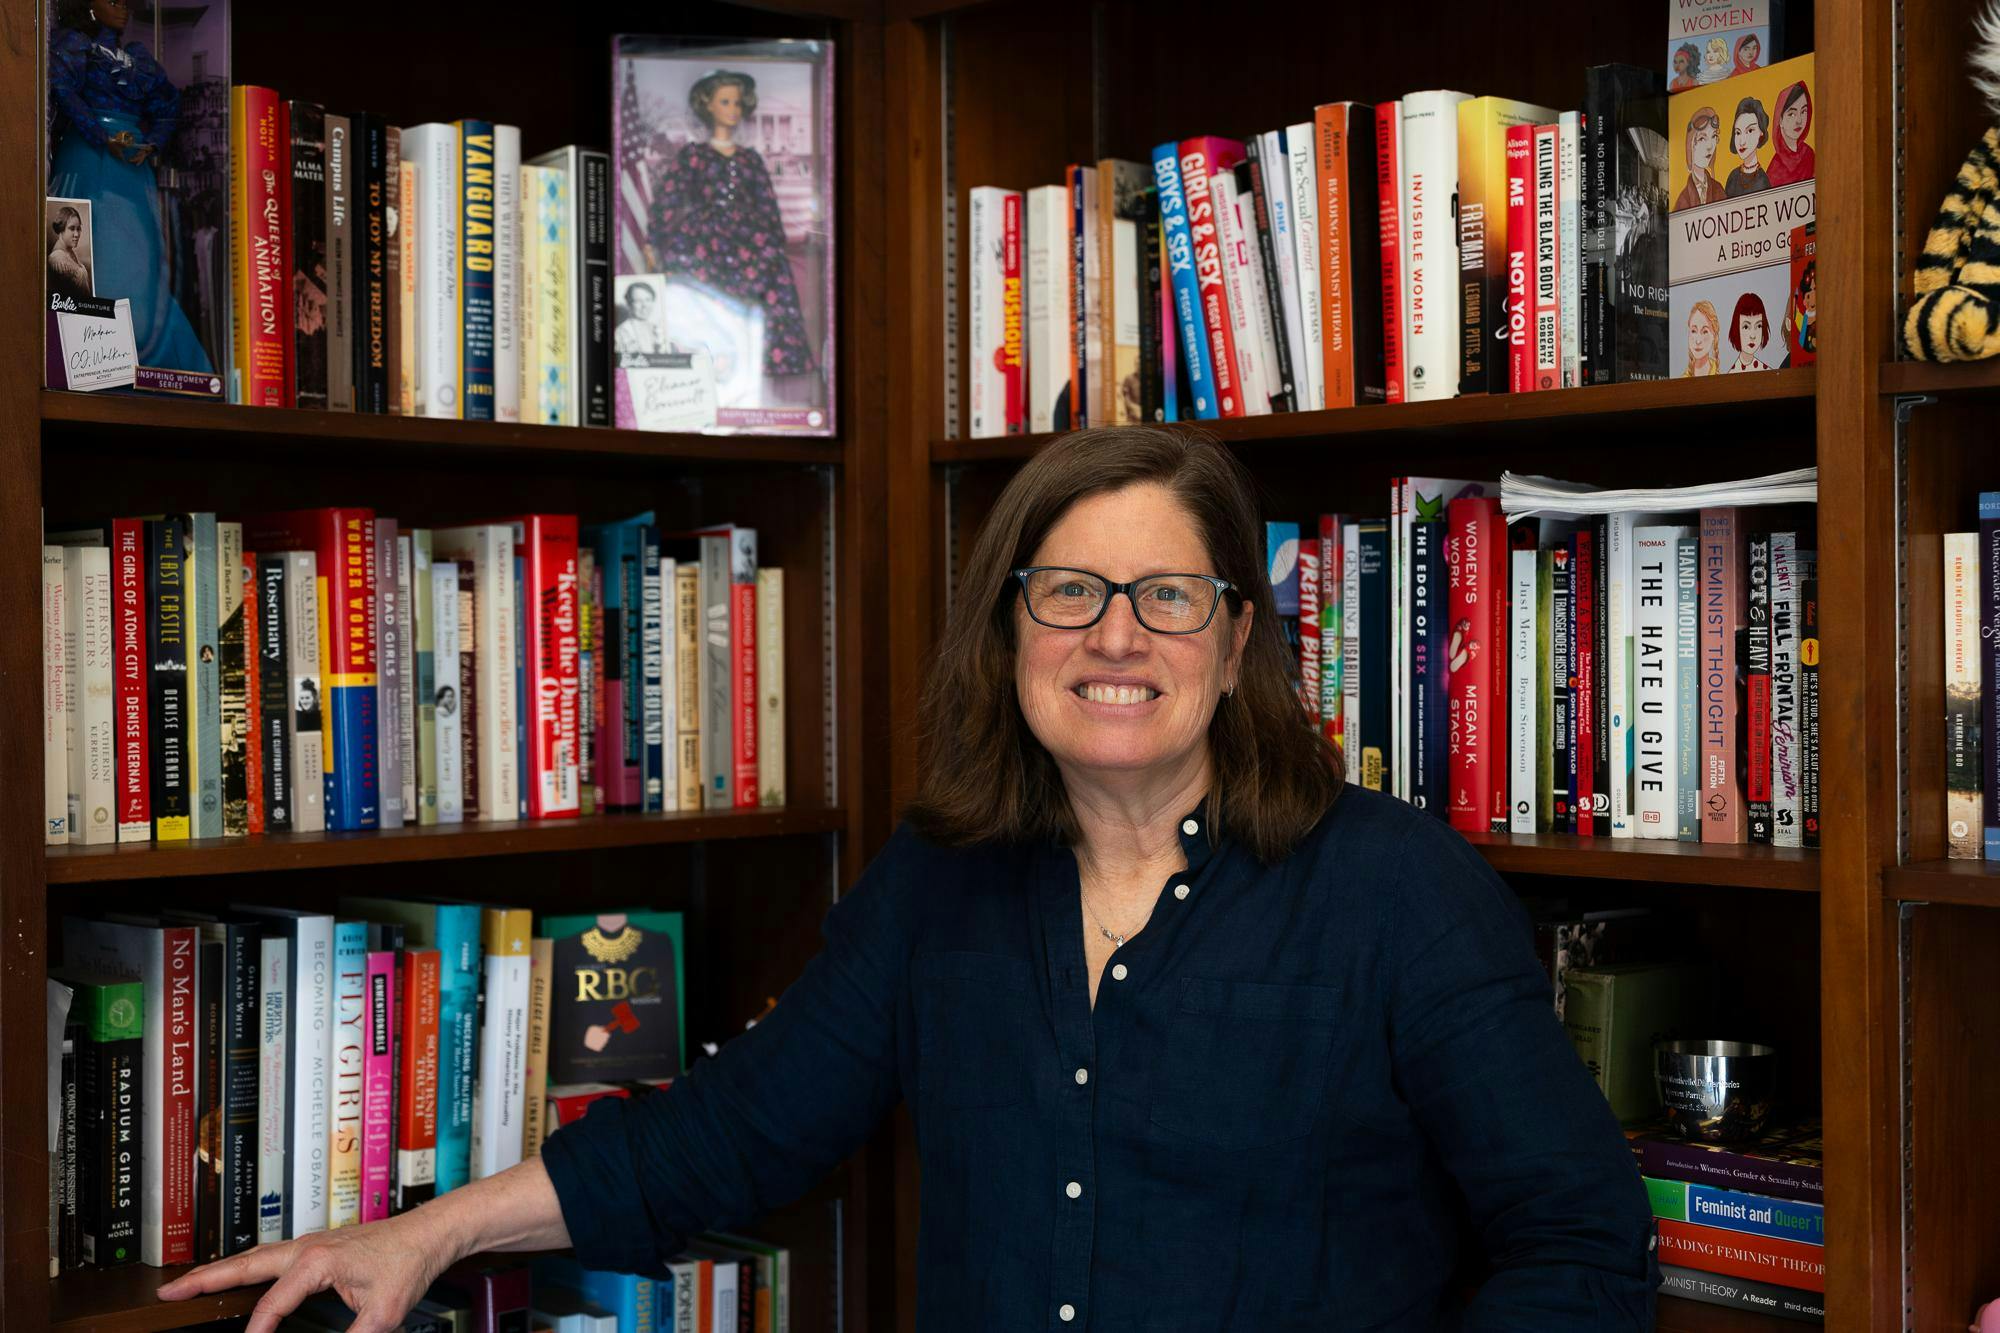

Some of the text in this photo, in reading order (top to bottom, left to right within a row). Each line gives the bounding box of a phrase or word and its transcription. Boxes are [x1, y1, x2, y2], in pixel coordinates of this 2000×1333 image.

[1682, 7, 1754, 33] WOMEN
[259, 118, 269, 148] HOLT
[266, 105, 276, 162] NATHALIA
[293, 170, 324, 182] MATER
[295, 160, 323, 172] ALMA
[331, 126, 345, 226] Campus Life
[369, 181, 381, 206] TO
[262, 169, 282, 281] The QUEENS of
[368, 212, 381, 245] JOY
[466, 134, 493, 273] VANGUARD
[1539, 137, 1554, 300] KILLING THE BLACK BODY
[1685, 203, 1769, 243] WONDER
[369, 250, 382, 277] MY
[1412, 173, 1424, 336] INVISIBLE WOMEN
[1461, 203, 1484, 271] FREEMAN
[1717, 244, 1726, 262] A
[1731, 238, 1772, 259] Bingo
[254, 235, 276, 335] ANIMATION
[1154, 156, 1201, 382] BOYS & SEX PEGGY ORENSTEIN
[1180, 151, 1231, 389] GIRLS & SEX PEGGY ORENSTEIN
[1510, 177, 1525, 393] ME NOT YOU Manchester
[51, 293, 111, 312] Barbie SIGNATURE
[370, 281, 382, 368] FREEDOM
[1004, 276, 1021, 367] PUSHOUT
[1465, 282, 1480, 325] LEONARD
[1465, 359, 1481, 377] JR.
[1539, 316, 1547, 365] ROBERTS
[1546, 316, 1555, 365] DOROTHY
[137, 370, 175, 383] INSPIRING
[159, 381, 183, 391] SERIES
[347, 518, 365, 666] WONDER WOMAN
[1450, 536, 1460, 588] WORK
[1465, 521, 1478, 604] WOMEN'S
[1749, 541, 1767, 605] HOT
[84, 575, 96, 667] DAUGHTERS
[97, 572, 111, 669] JEFFERSON'S
[261, 566, 284, 662] Rosemary
[643, 575, 662, 678] HOMEWARD
[1417, 525, 1427, 675] THE EDGE OF SEX
[1679, 545, 1696, 658] HAND to MOUTH
[1750, 606, 1765, 623] &
[122, 530, 142, 793] THE GIRLS OF ATOMIC CITY DENISE KIERNAN
[1322, 626, 1336, 721] UNFIT PARENT
[1554, 597, 1567, 750] TRANSGENDER HISTORY SUSAN STRYKER
[1708, 544, 1724, 748] FEMINIST THOUGHT
[1749, 626, 1768, 672] HEAVY
[1772, 545, 1797, 801] VALENTI FULL FRONTAL Feminism
[1517, 580, 1531, 774] Just Mercy Bryan Stevenson
[1641, 561, 1663, 793] THE HATE U GIVE
[1810, 672, 1818, 689] HE'S
[271, 720, 281, 737] KATE
[643, 684, 662, 746] BOUND
[1450, 698, 1460, 754] STACK
[1465, 684, 1478, 769] MEGAN K.
[1809, 698, 1818, 720] STUD,
[1810, 722, 1818, 743] SHE'S
[272, 738, 282, 771] CLIFFORD
[1811, 753, 1819, 771] SLUT
[273, 773, 283, 801] LARSON
[171, 939, 190, 1097] No Man's Land
[340, 971, 363, 1032] FLY
[374, 977, 386, 1053] UNMENTIONABLE
[119, 1068, 131, 1142] RADIUM
[310, 940, 326, 1211] BECOMING MICHELLE OBAMA
[337, 1044, 363, 1154] GIRLS
[119, 1152, 131, 1209] GIRLS
[1666, 1159, 1694, 1170] Introduction
[1700, 1163, 1732, 1177] Women's,
[1733, 1169, 1758, 1182] Gender
[1759, 1174, 1767, 1183] &
[1768, 1174, 1800, 1190] Sexuality
[108, 1229, 134, 1239] MOORE
[111, 1221, 130, 1231] KATE
[1695, 1196, 1746, 1222] Feminist
[1749, 1208, 1772, 1225] and
[1775, 1210, 1811, 1232] Queer
[1814, 1215, 1824, 1234] T
[1658, 1234, 1713, 1257] READING
[1717, 1246, 1779, 1269] FEMINIST
[1662, 1275, 1697, 1293] MINIST
[1698, 1281, 1739, 1300] THEORY
[1742, 1293, 1750, 1303] A
[1750, 1294, 1777, 1308] Reader
[1784, 1301, 1802, 1313] third
